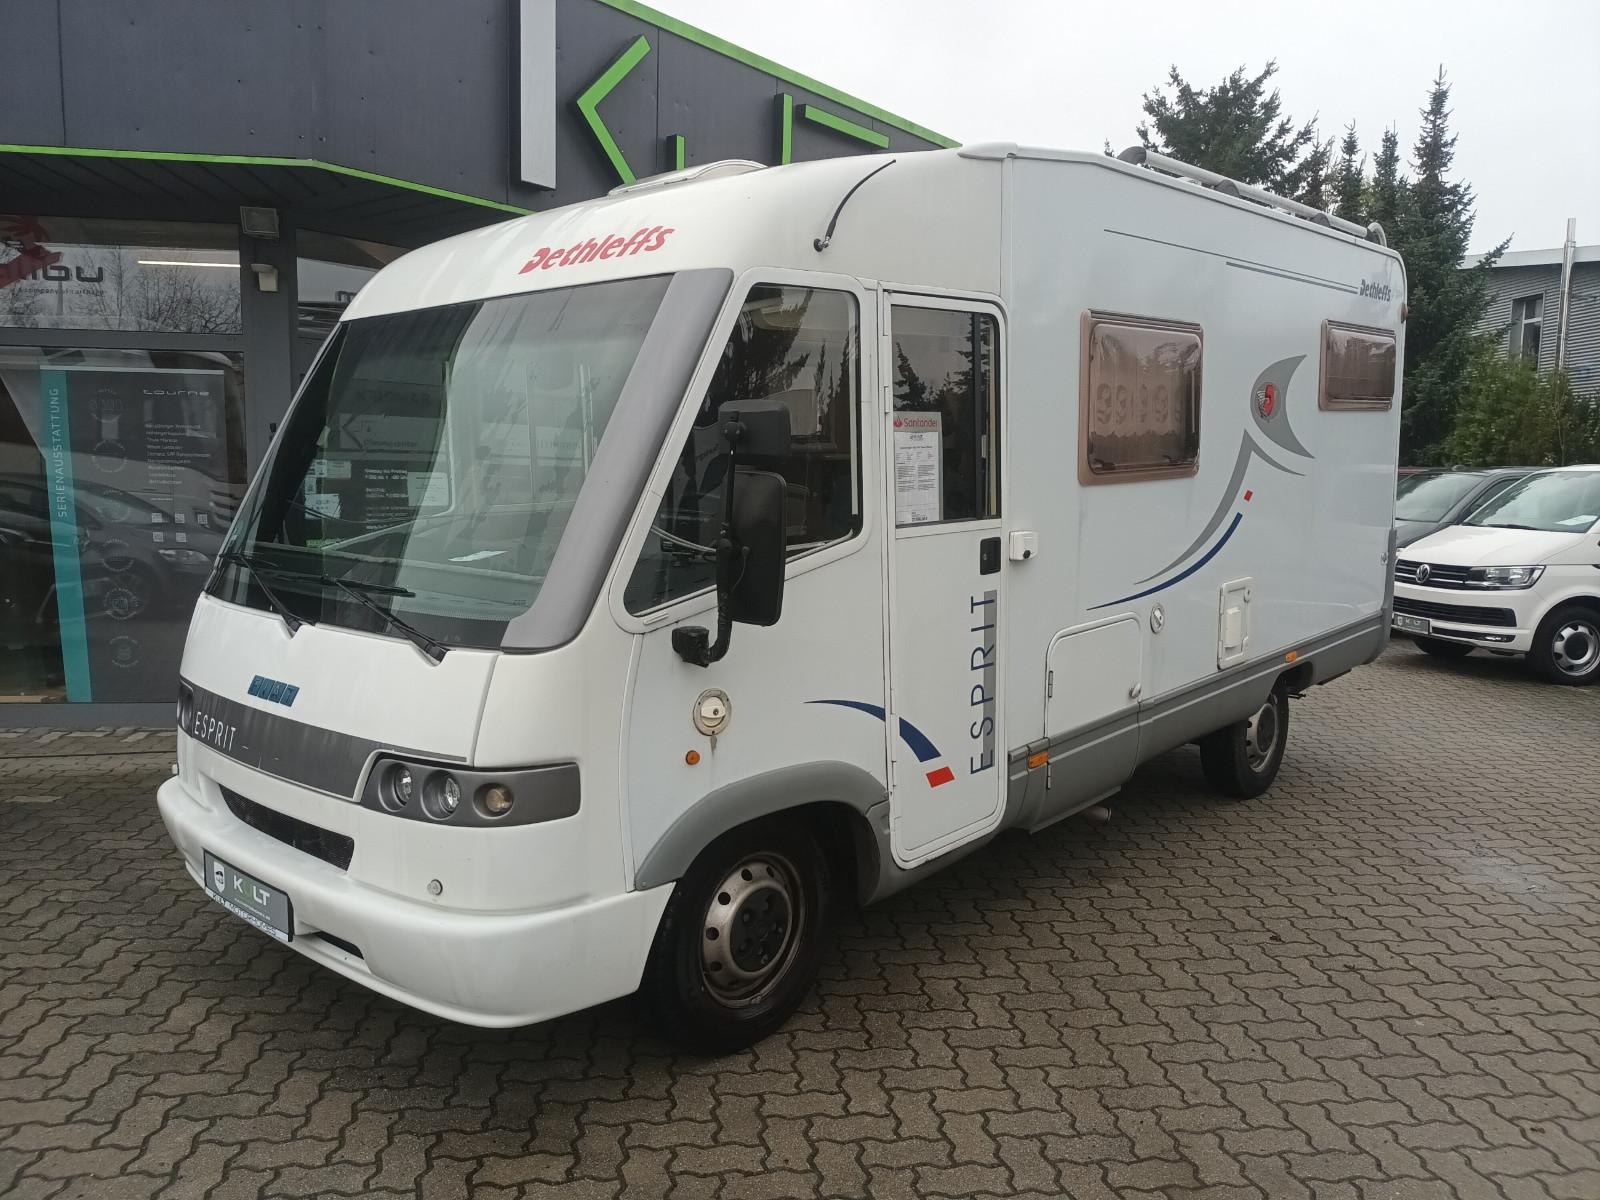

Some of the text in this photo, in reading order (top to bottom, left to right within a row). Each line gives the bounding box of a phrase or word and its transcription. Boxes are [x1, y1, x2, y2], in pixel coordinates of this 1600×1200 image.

[519, 225, 675, 275] Dethleffs
[1359, 278, 1391, 302] Dethleffs
[903, 417, 938, 428] Santander
[49, 386, 69, 519] SERIENAUSSTATTUNG
[248, 675, 300, 707] FIAT
[970, 595, 996, 775] ESPRIT
[193, 710, 238, 752] ESPRIT
